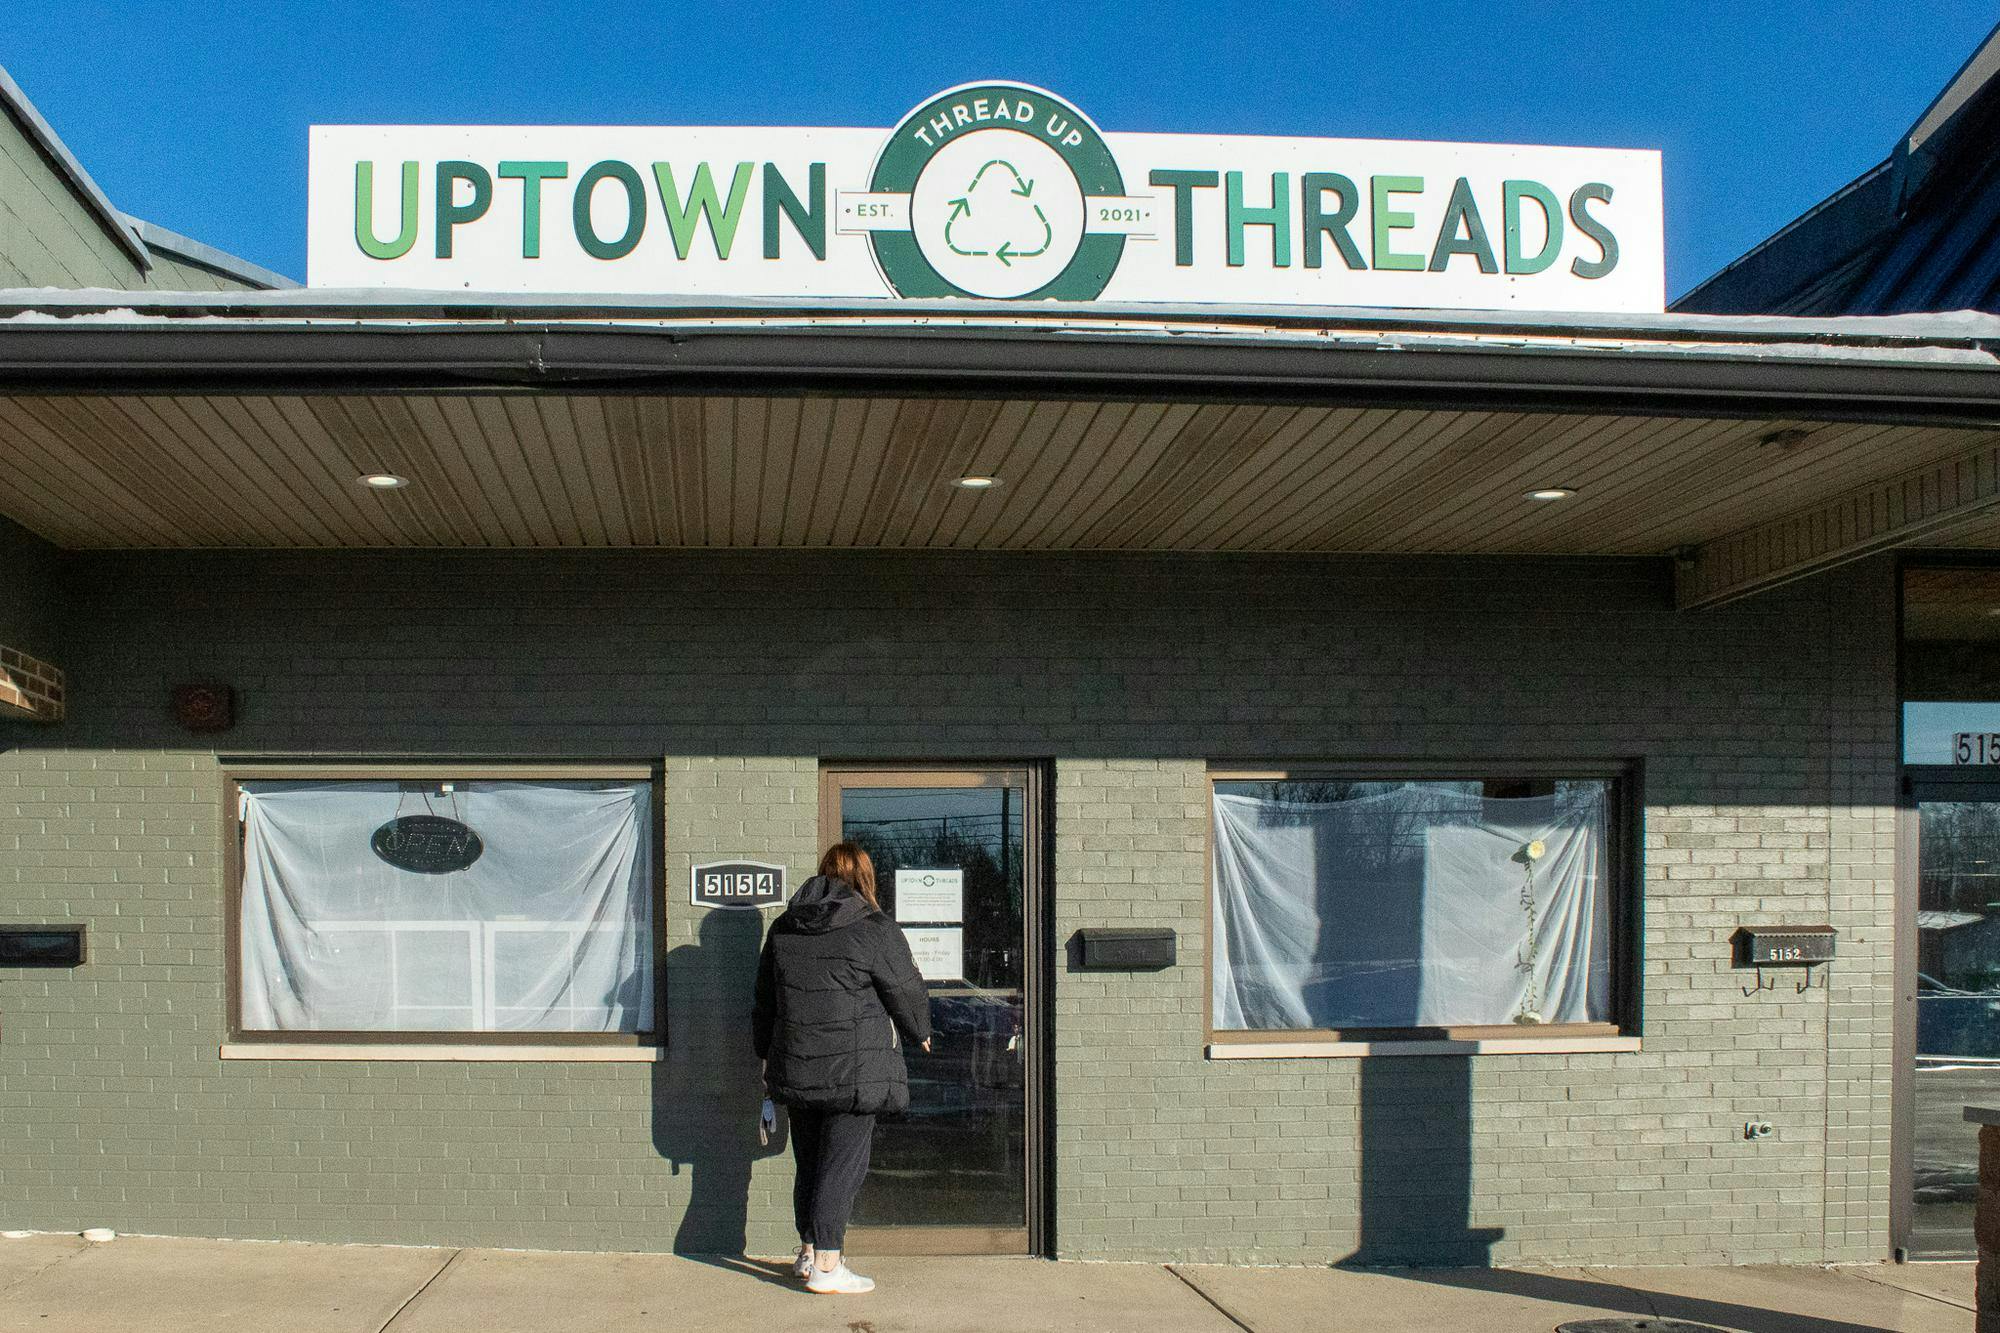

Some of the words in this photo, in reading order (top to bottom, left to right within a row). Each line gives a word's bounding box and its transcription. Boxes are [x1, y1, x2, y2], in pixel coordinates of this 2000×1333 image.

[914, 98, 1034, 149] THREAD
[1046, 113, 1083, 149] UP
[354, 159, 827, 260] UPTOWN
[1148, 168, 1619, 279] THREADS
[857, 203, 894, 218] EST.
[1100, 208, 1141, 222] 2021
[386, 831, 471, 856] OPEN
[707, 874, 772, 895] 5154
[1770, 948, 1801, 961] 5152
